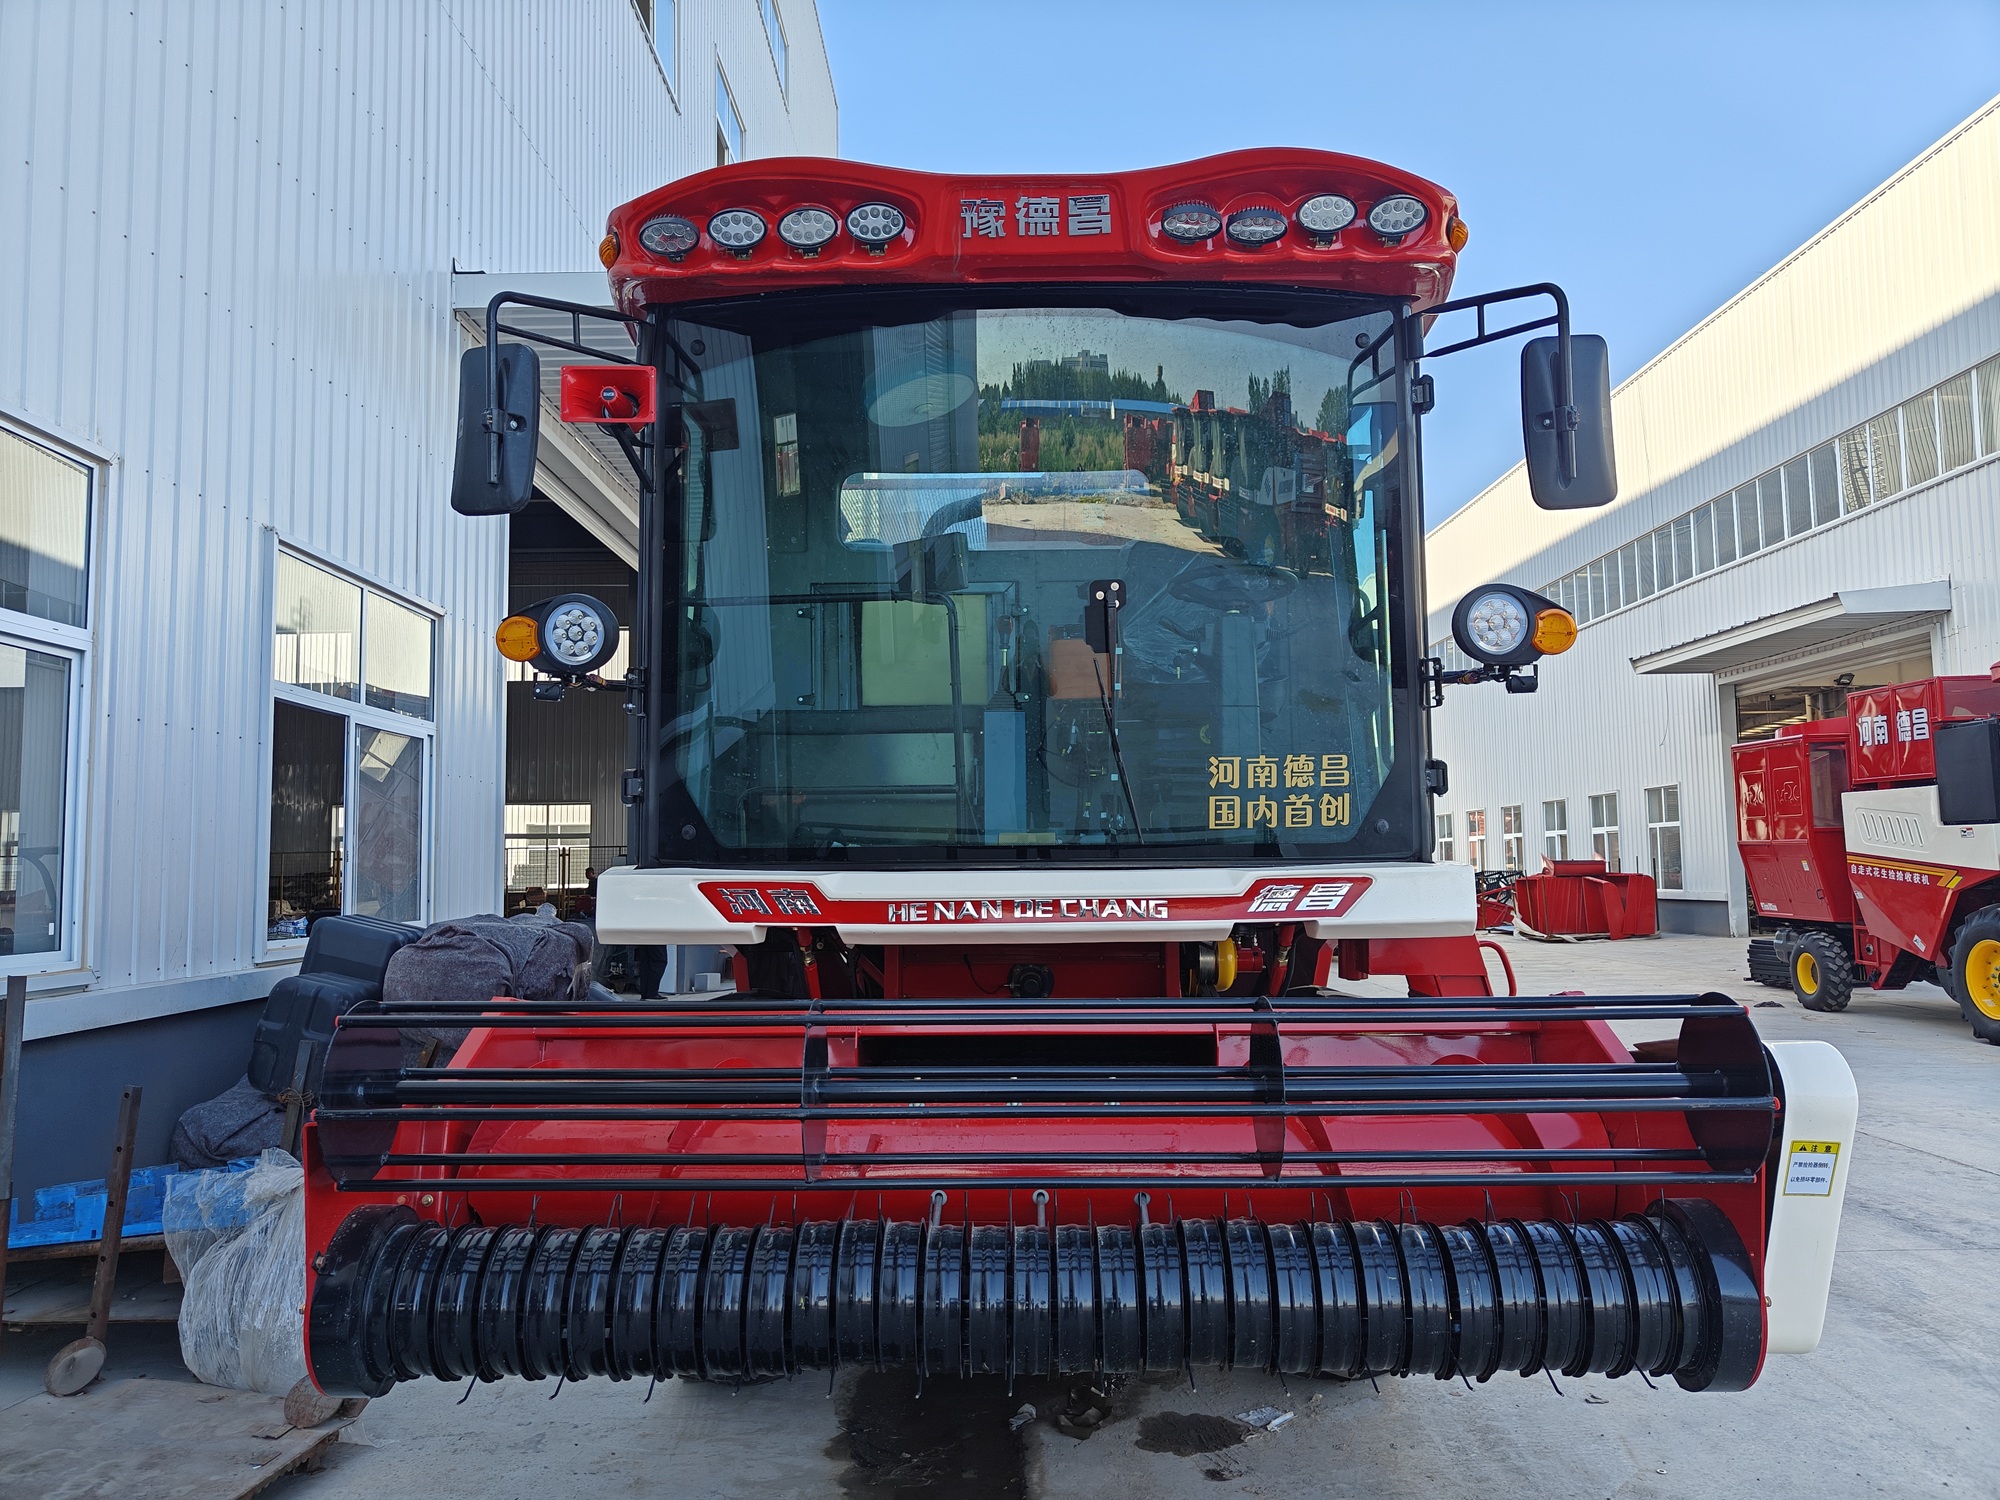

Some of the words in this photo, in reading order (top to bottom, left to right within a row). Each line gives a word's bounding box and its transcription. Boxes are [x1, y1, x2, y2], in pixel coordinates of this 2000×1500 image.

[959, 194, 1112, 238] 豫德昌
[1857, 714, 1888, 747] 河南
[1896, 707, 1930, 742] 德昌
[1208, 754, 1350, 789] 河南德昌
[1208, 793, 1350, 830] 国内首创
[717, 887, 822, 915] 河南
[1013, 900, 1054, 918] DE
[1060, 899, 1168, 918] CHANG
[1247, 883, 1354, 912] 德昌
